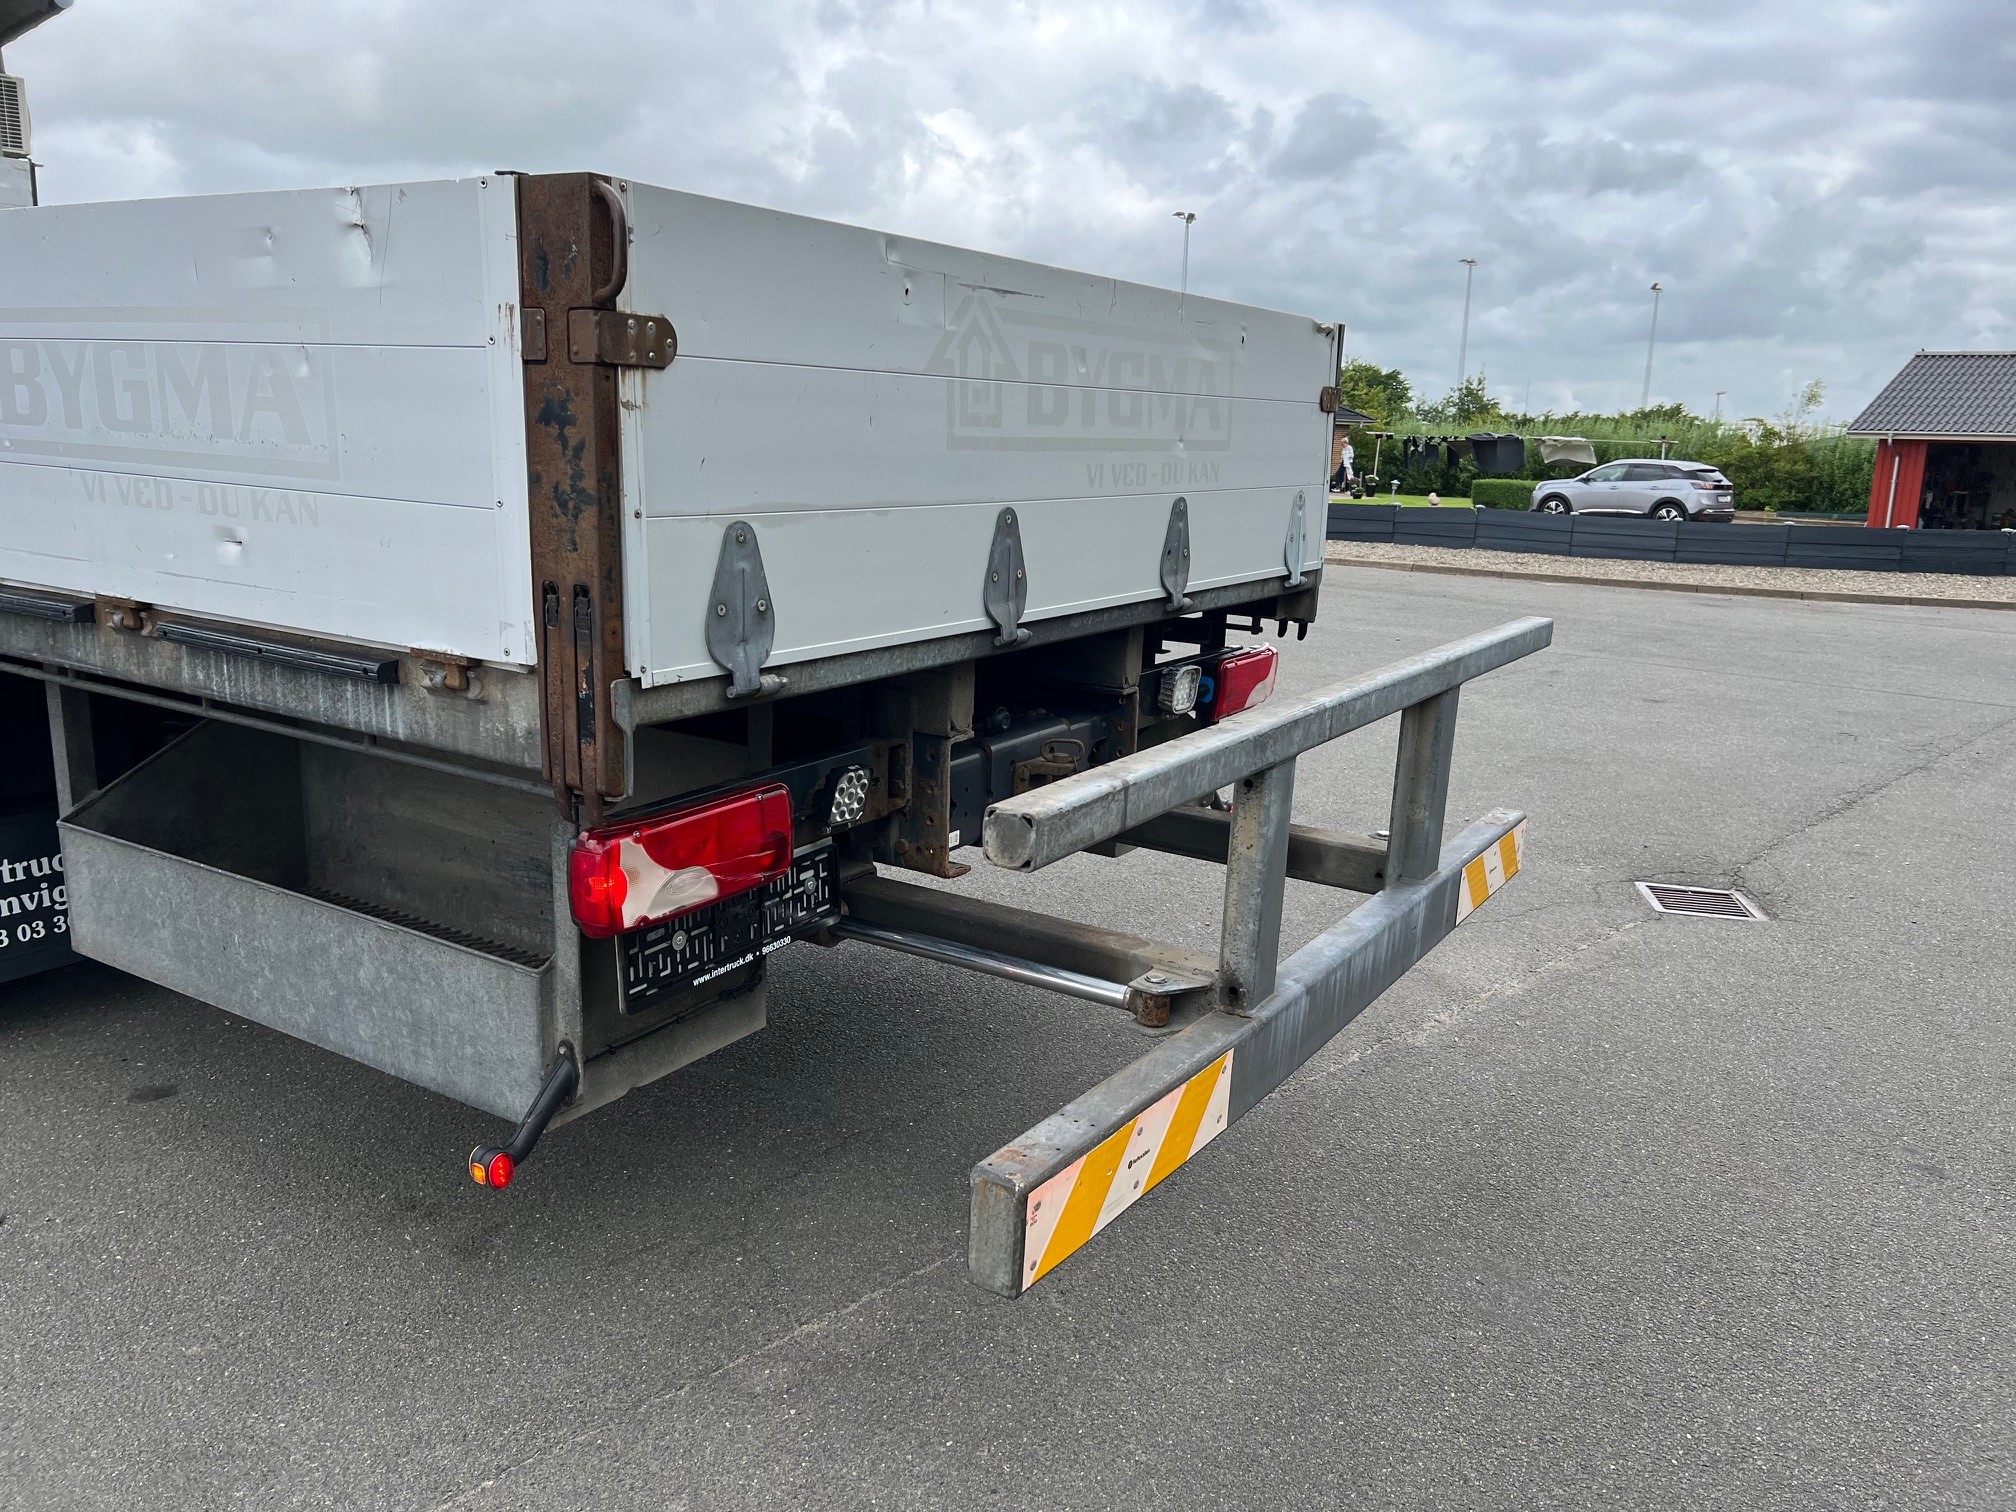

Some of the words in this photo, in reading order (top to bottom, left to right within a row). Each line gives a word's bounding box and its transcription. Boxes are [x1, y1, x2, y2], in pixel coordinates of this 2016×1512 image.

[0, 341, 312, 446] BYGMA
[1026, 339, 1222, 430] BYGMA
[1085, 463, 1104, 488] VI
[1161, 461, 1184, 485] DU
[1188, 461, 1220, 483] KAN
[79, 472, 107, 503] VI
[198, 484, 240, 518] DU
[252, 489, 320, 527] KAN
[16, 920, 46, 942] 03
[692, 952, 754, 986] www.intertruck.dk
